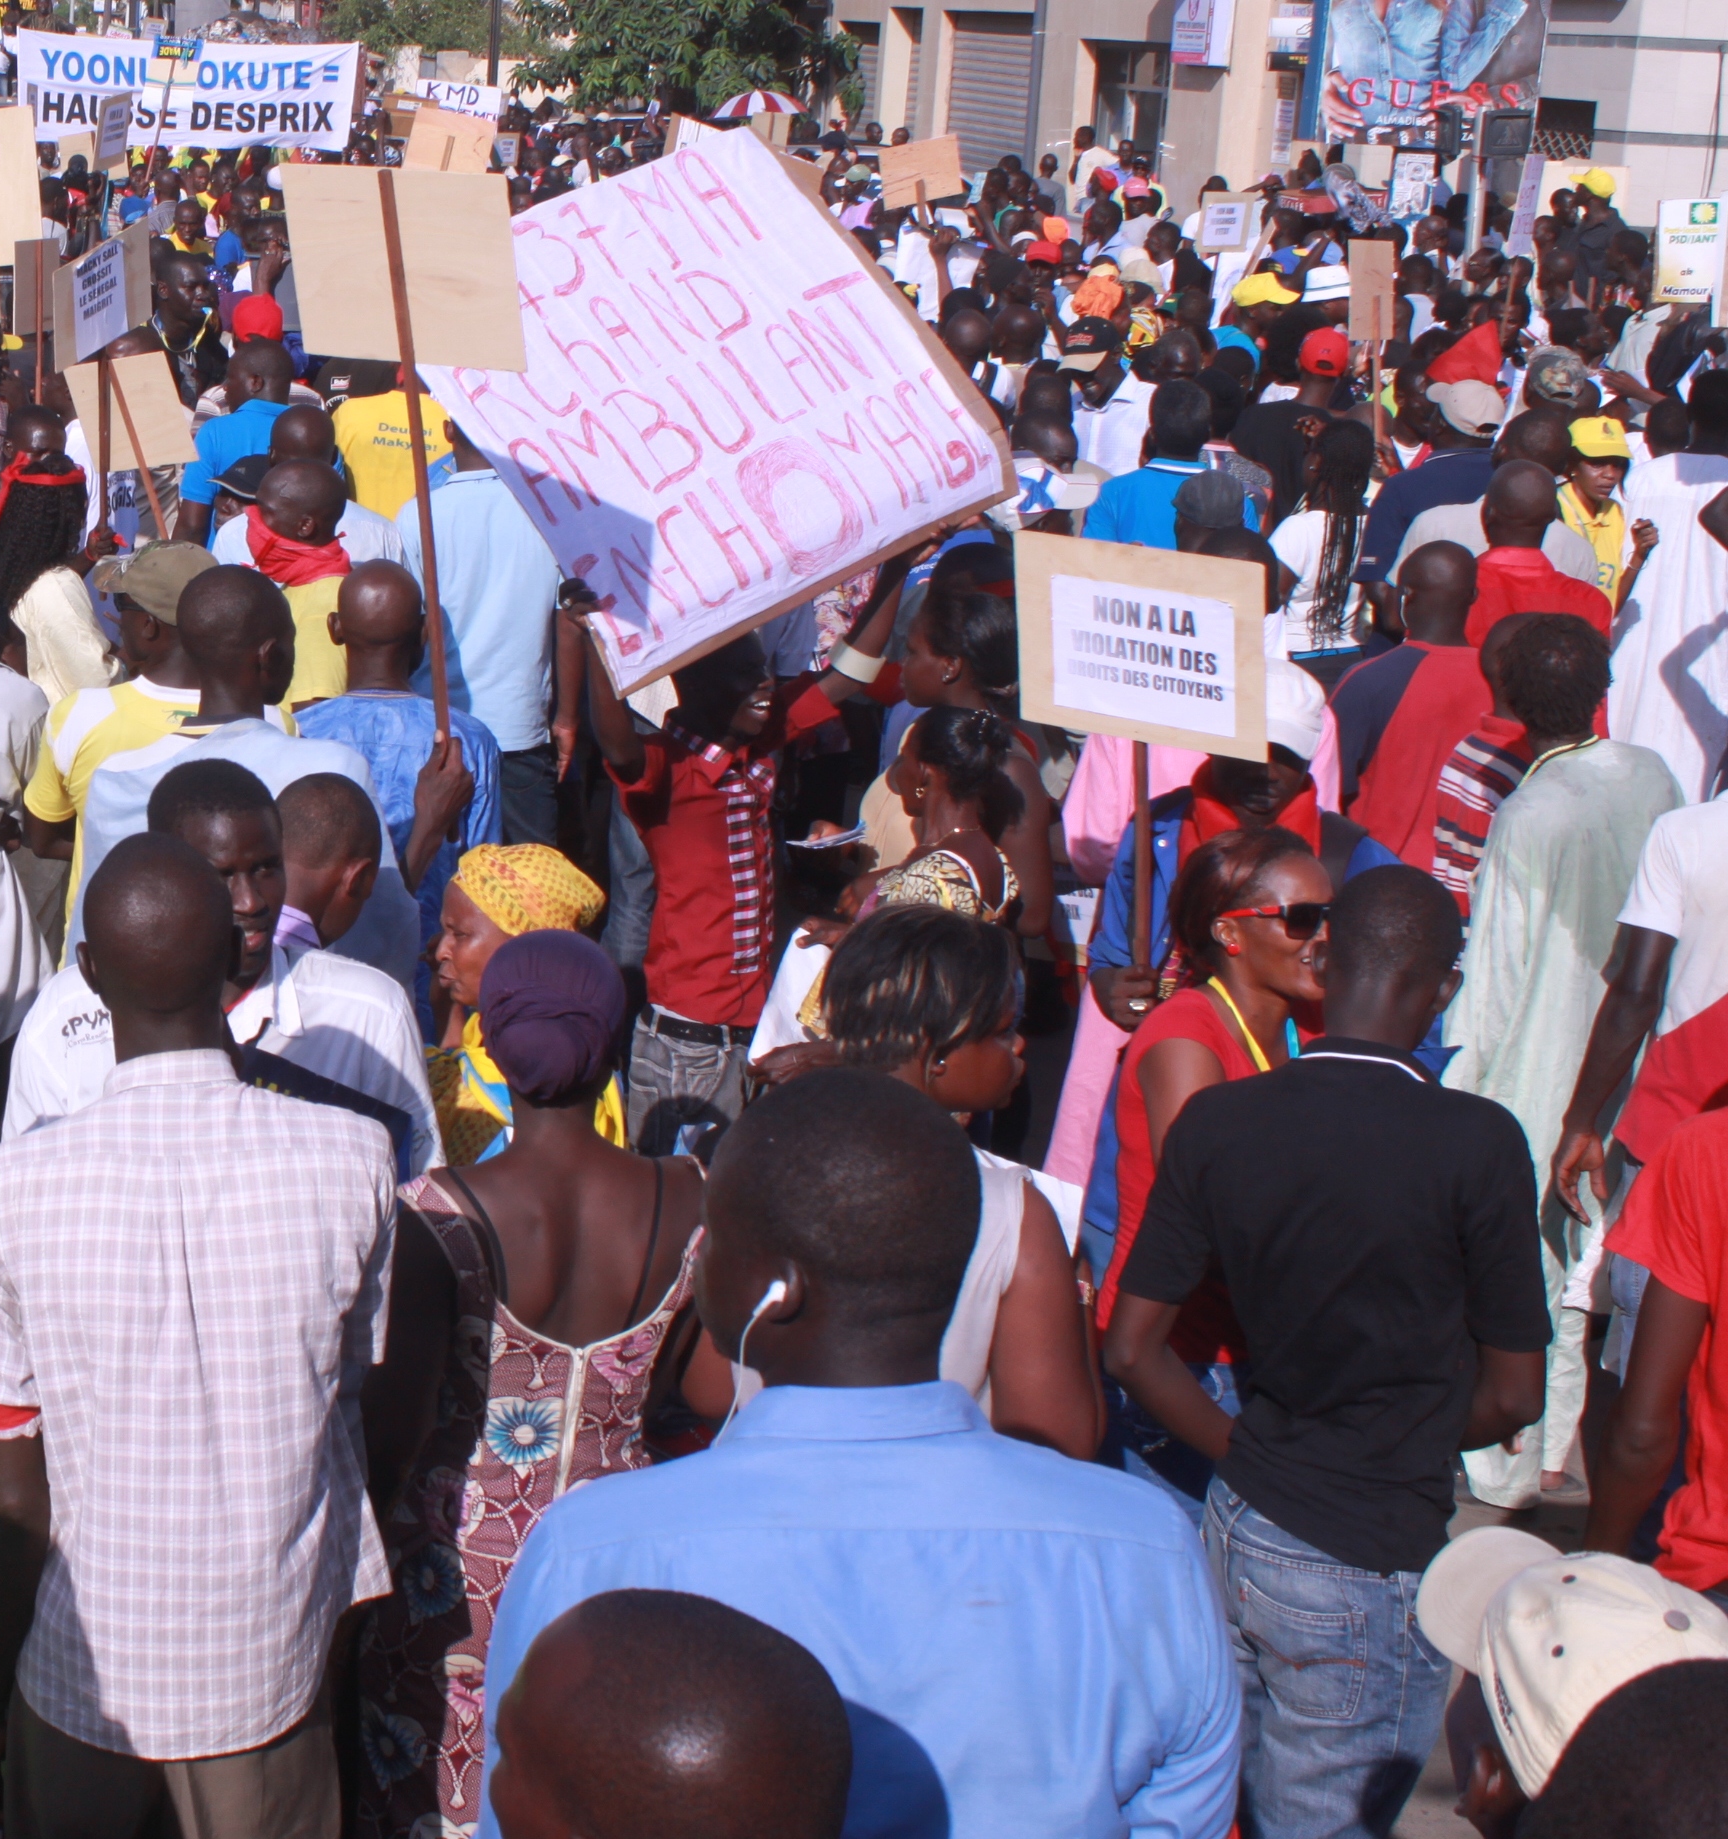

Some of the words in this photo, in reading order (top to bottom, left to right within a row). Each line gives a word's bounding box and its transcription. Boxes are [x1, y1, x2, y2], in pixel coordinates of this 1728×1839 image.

[196, 61, 312, 91] OKUTE
[42, 91, 177, 130] HAUSE
[1347, 77, 1521, 113] GUESS
[1375, 114, 1430, 127] ALMADIES
[76, 255, 101, 278] MACKY
[102, 244, 119, 262] SALL
[82, 264, 112, 291] GROSSIT
[79, 294, 88, 308] LE
[88, 276, 118, 303] SENEGAL
[83, 294, 113, 321] MAIGRIT
[1660, 286, 1708, 296] Mamour
[508, 271, 869, 527] AMBULANT
[372, 436, 437, 453] Makya!
[1092, 595, 1141, 628] NON
[1147, 604, 1162, 632] A
[1168, 608, 1196, 637] LA
[1071, 629, 1173, 667] VIOLATION
[1179, 648, 1217, 676] DES
[1068, 658, 1119, 682] DROITS
[1122, 668, 1149, 688] DES
[1152, 674, 1224, 701] CITOYENS
